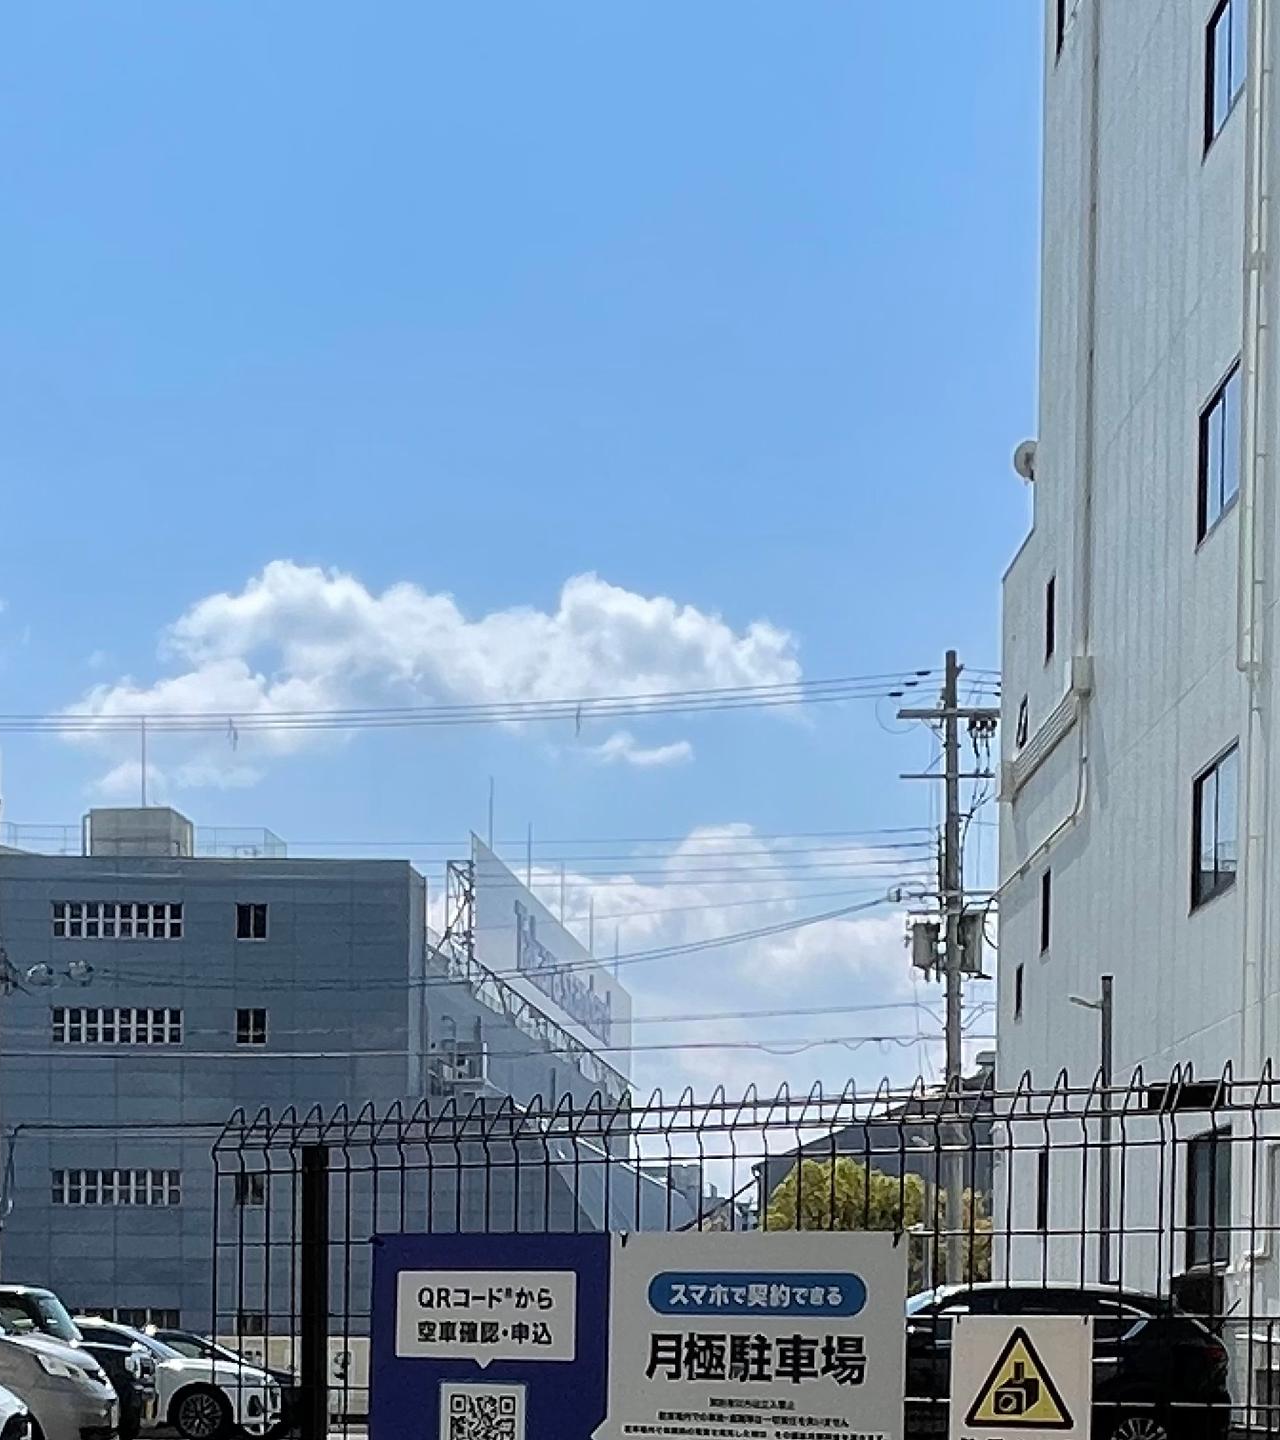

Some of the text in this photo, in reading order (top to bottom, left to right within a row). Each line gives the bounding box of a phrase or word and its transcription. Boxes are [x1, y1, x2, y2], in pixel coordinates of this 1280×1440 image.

[669, 1283, 844, 1308] スマホで契約できる
[417, 1321, 553, 1345] 空車確認・申込
[645, 1332, 867, 1386] 月極駐車場
